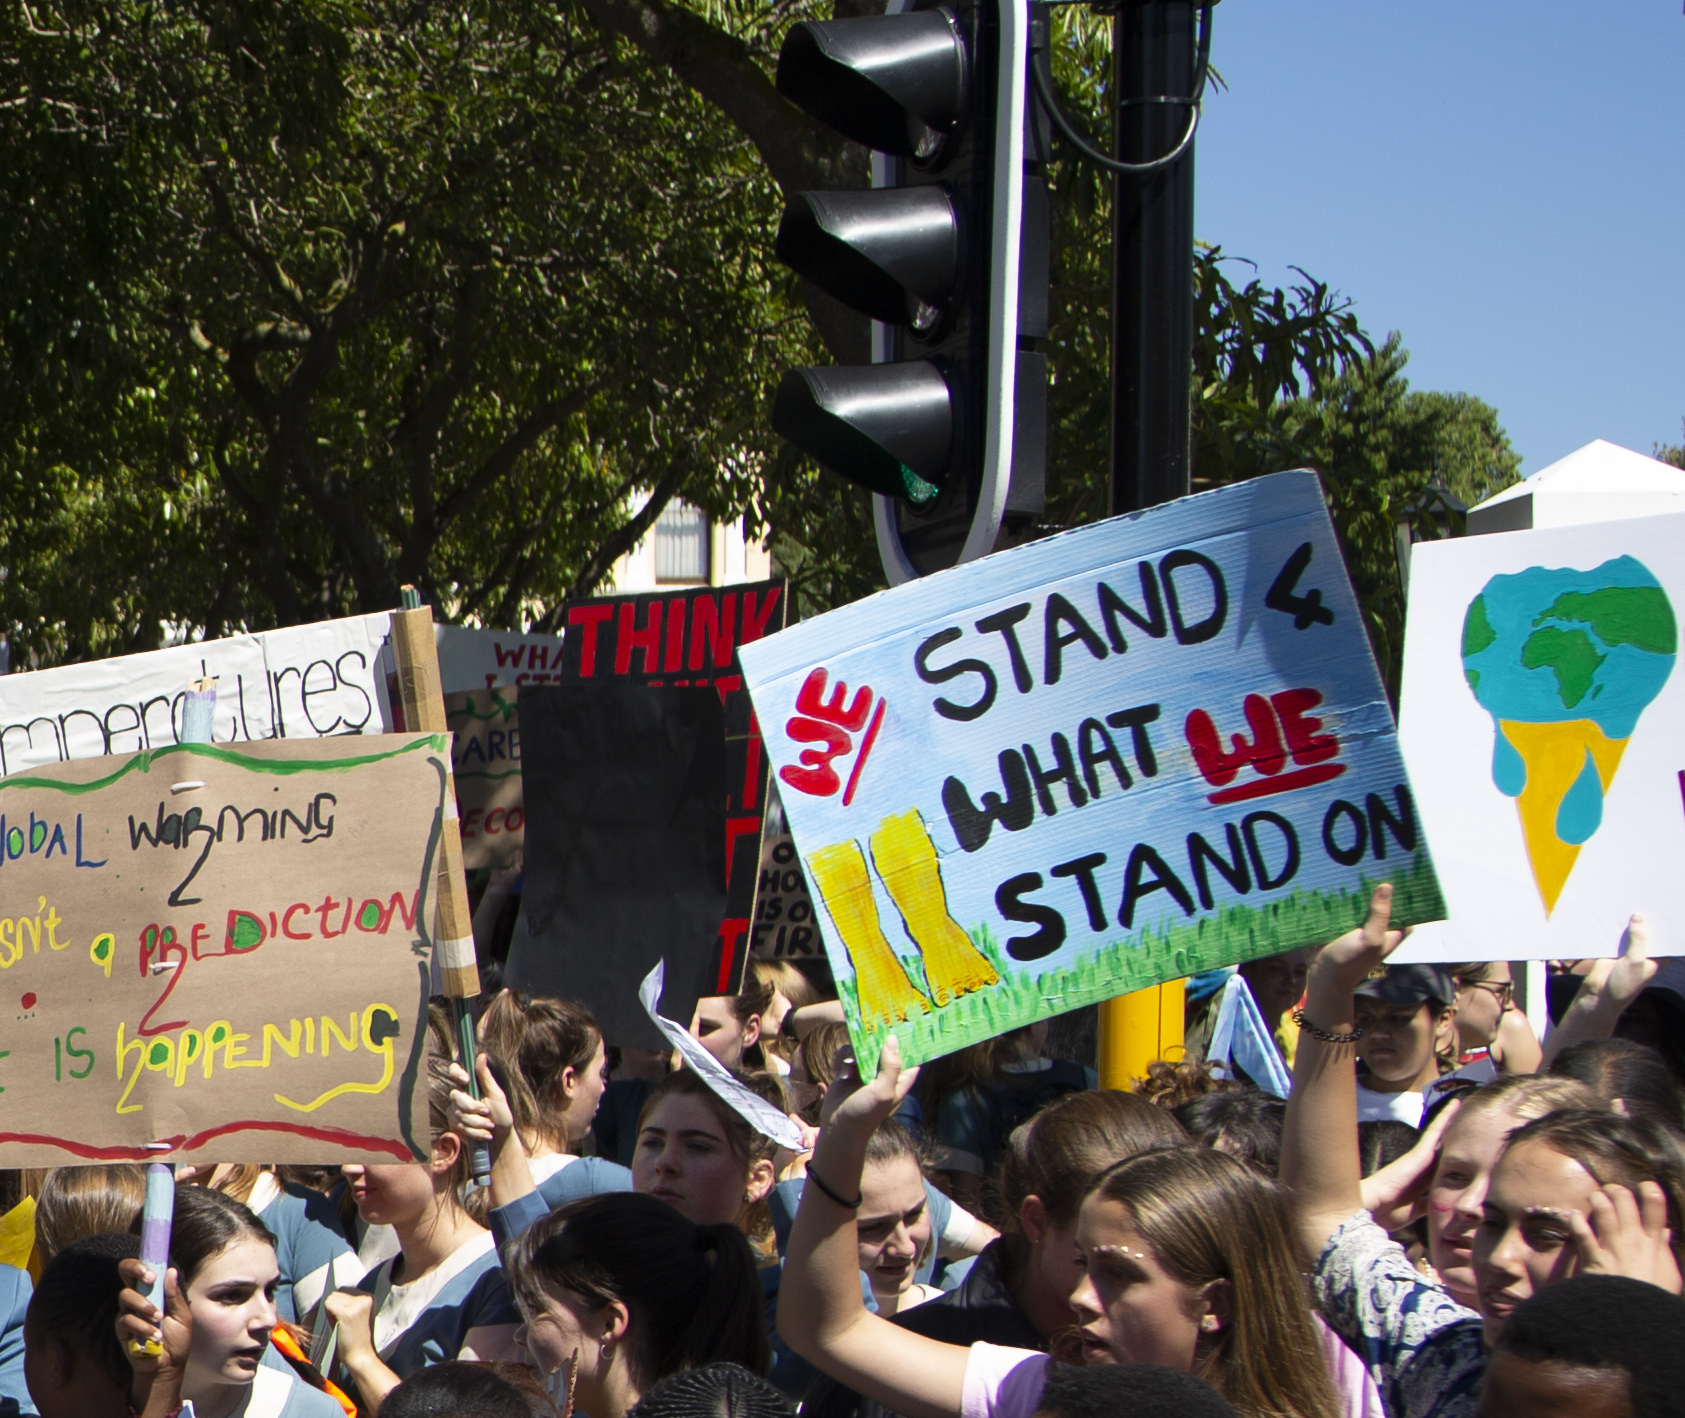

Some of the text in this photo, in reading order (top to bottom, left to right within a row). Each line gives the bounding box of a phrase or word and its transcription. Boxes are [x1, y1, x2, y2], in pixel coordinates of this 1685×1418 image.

[568, 586, 783, 677] THINK
[780, 542, 1334, 798] WE STAND 4
[941, 688, 1340, 853] WHAT WE
[996, 784, 1416, 961] STAND ON
